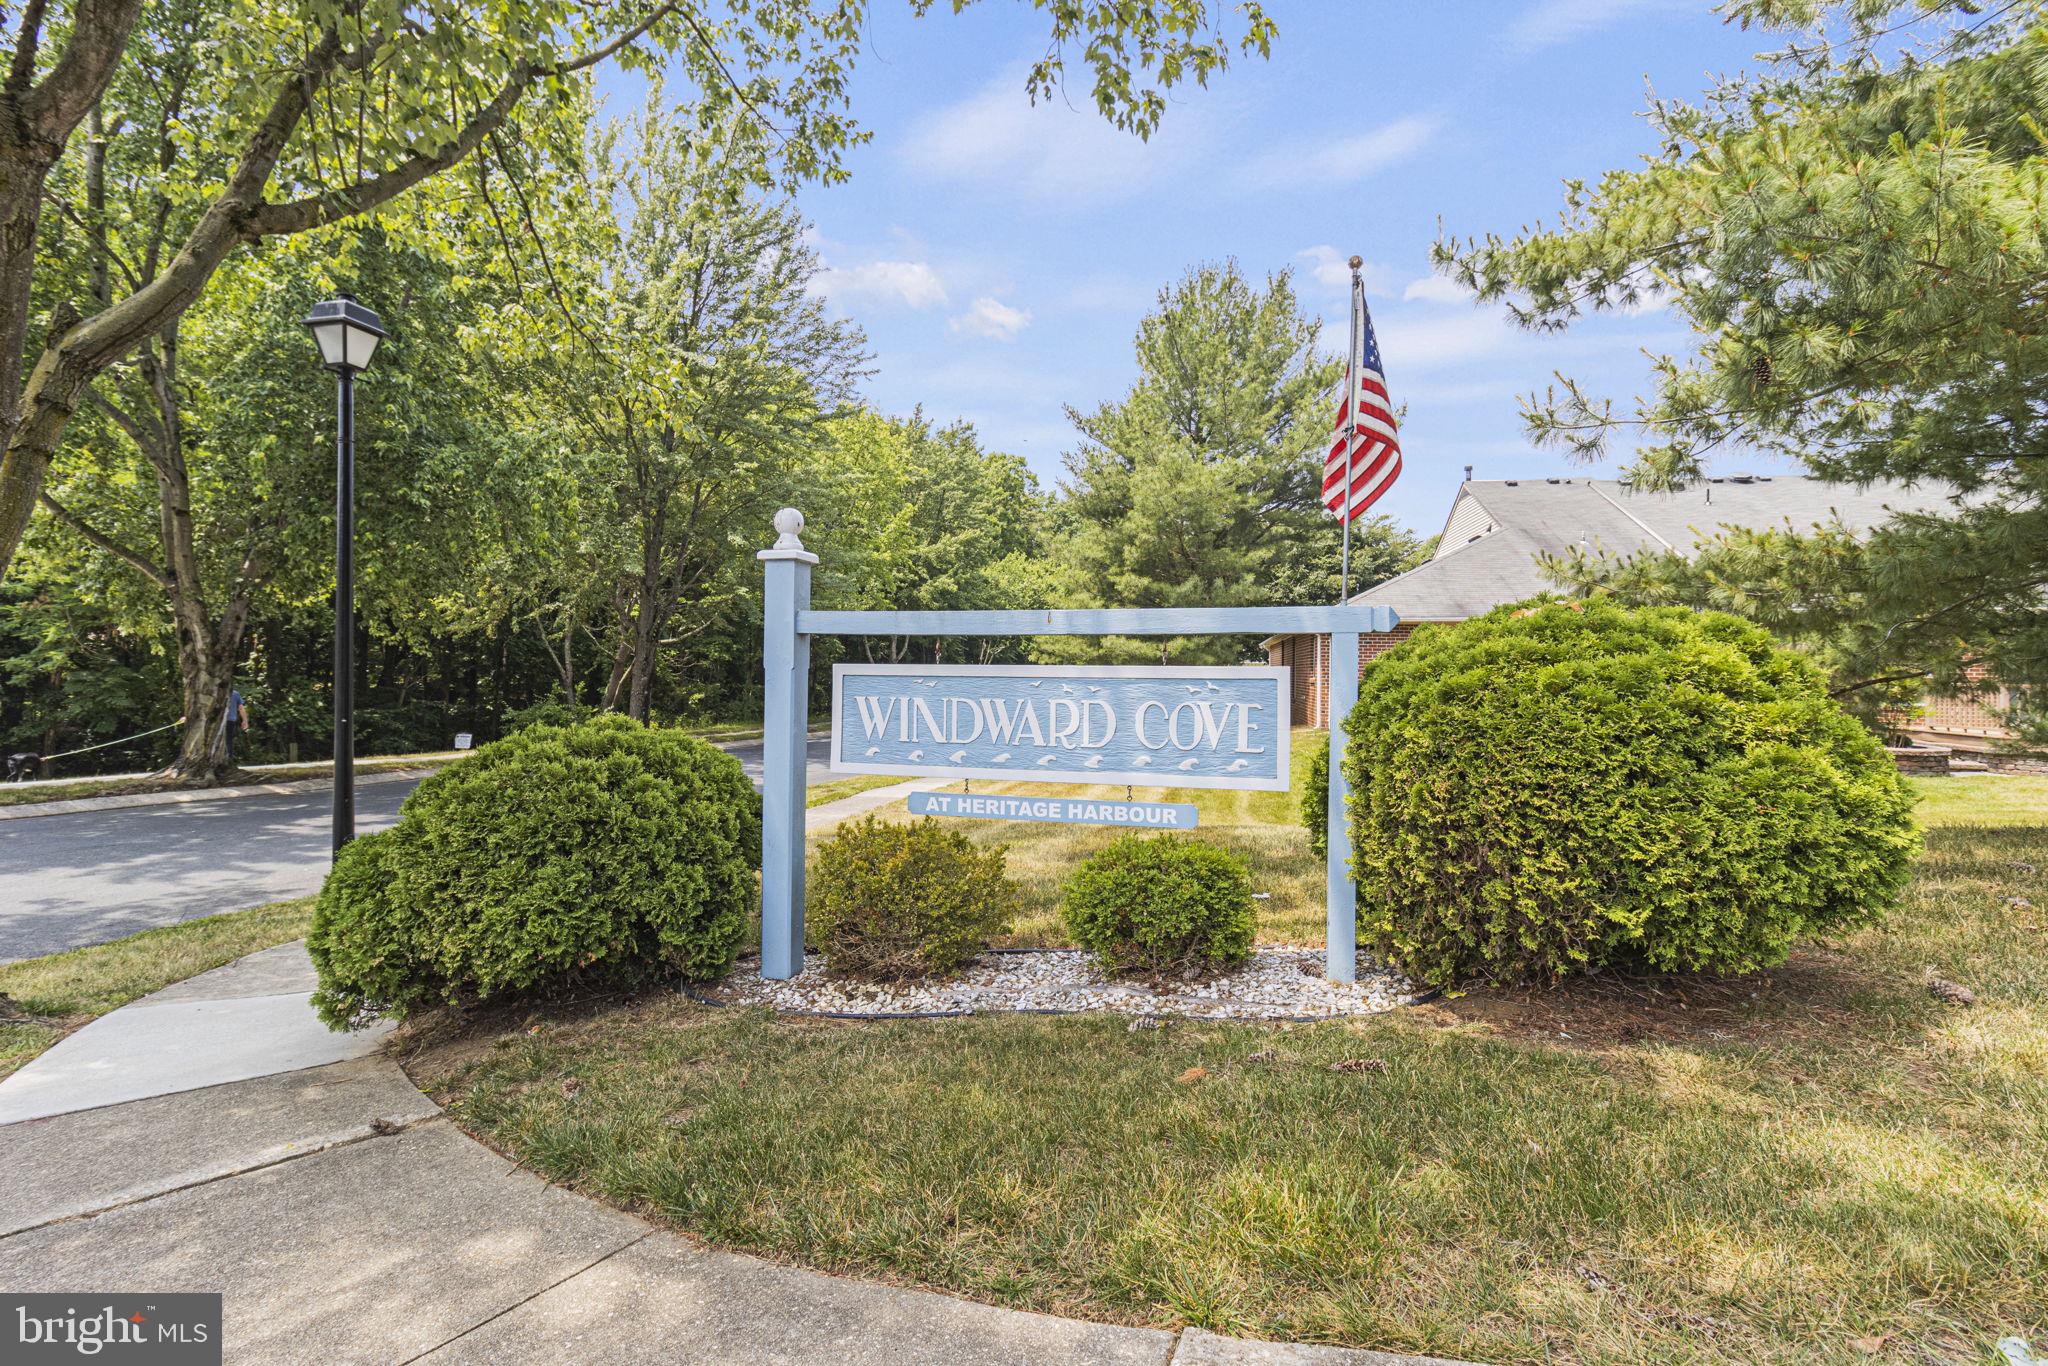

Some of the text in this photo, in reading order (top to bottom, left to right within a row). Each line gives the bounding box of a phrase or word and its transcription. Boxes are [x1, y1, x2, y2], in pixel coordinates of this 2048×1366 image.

[854, 696, 1265, 754] WINDWARD COVE
[926, 797, 1177, 824] AT HERITAGE HARBOUR
